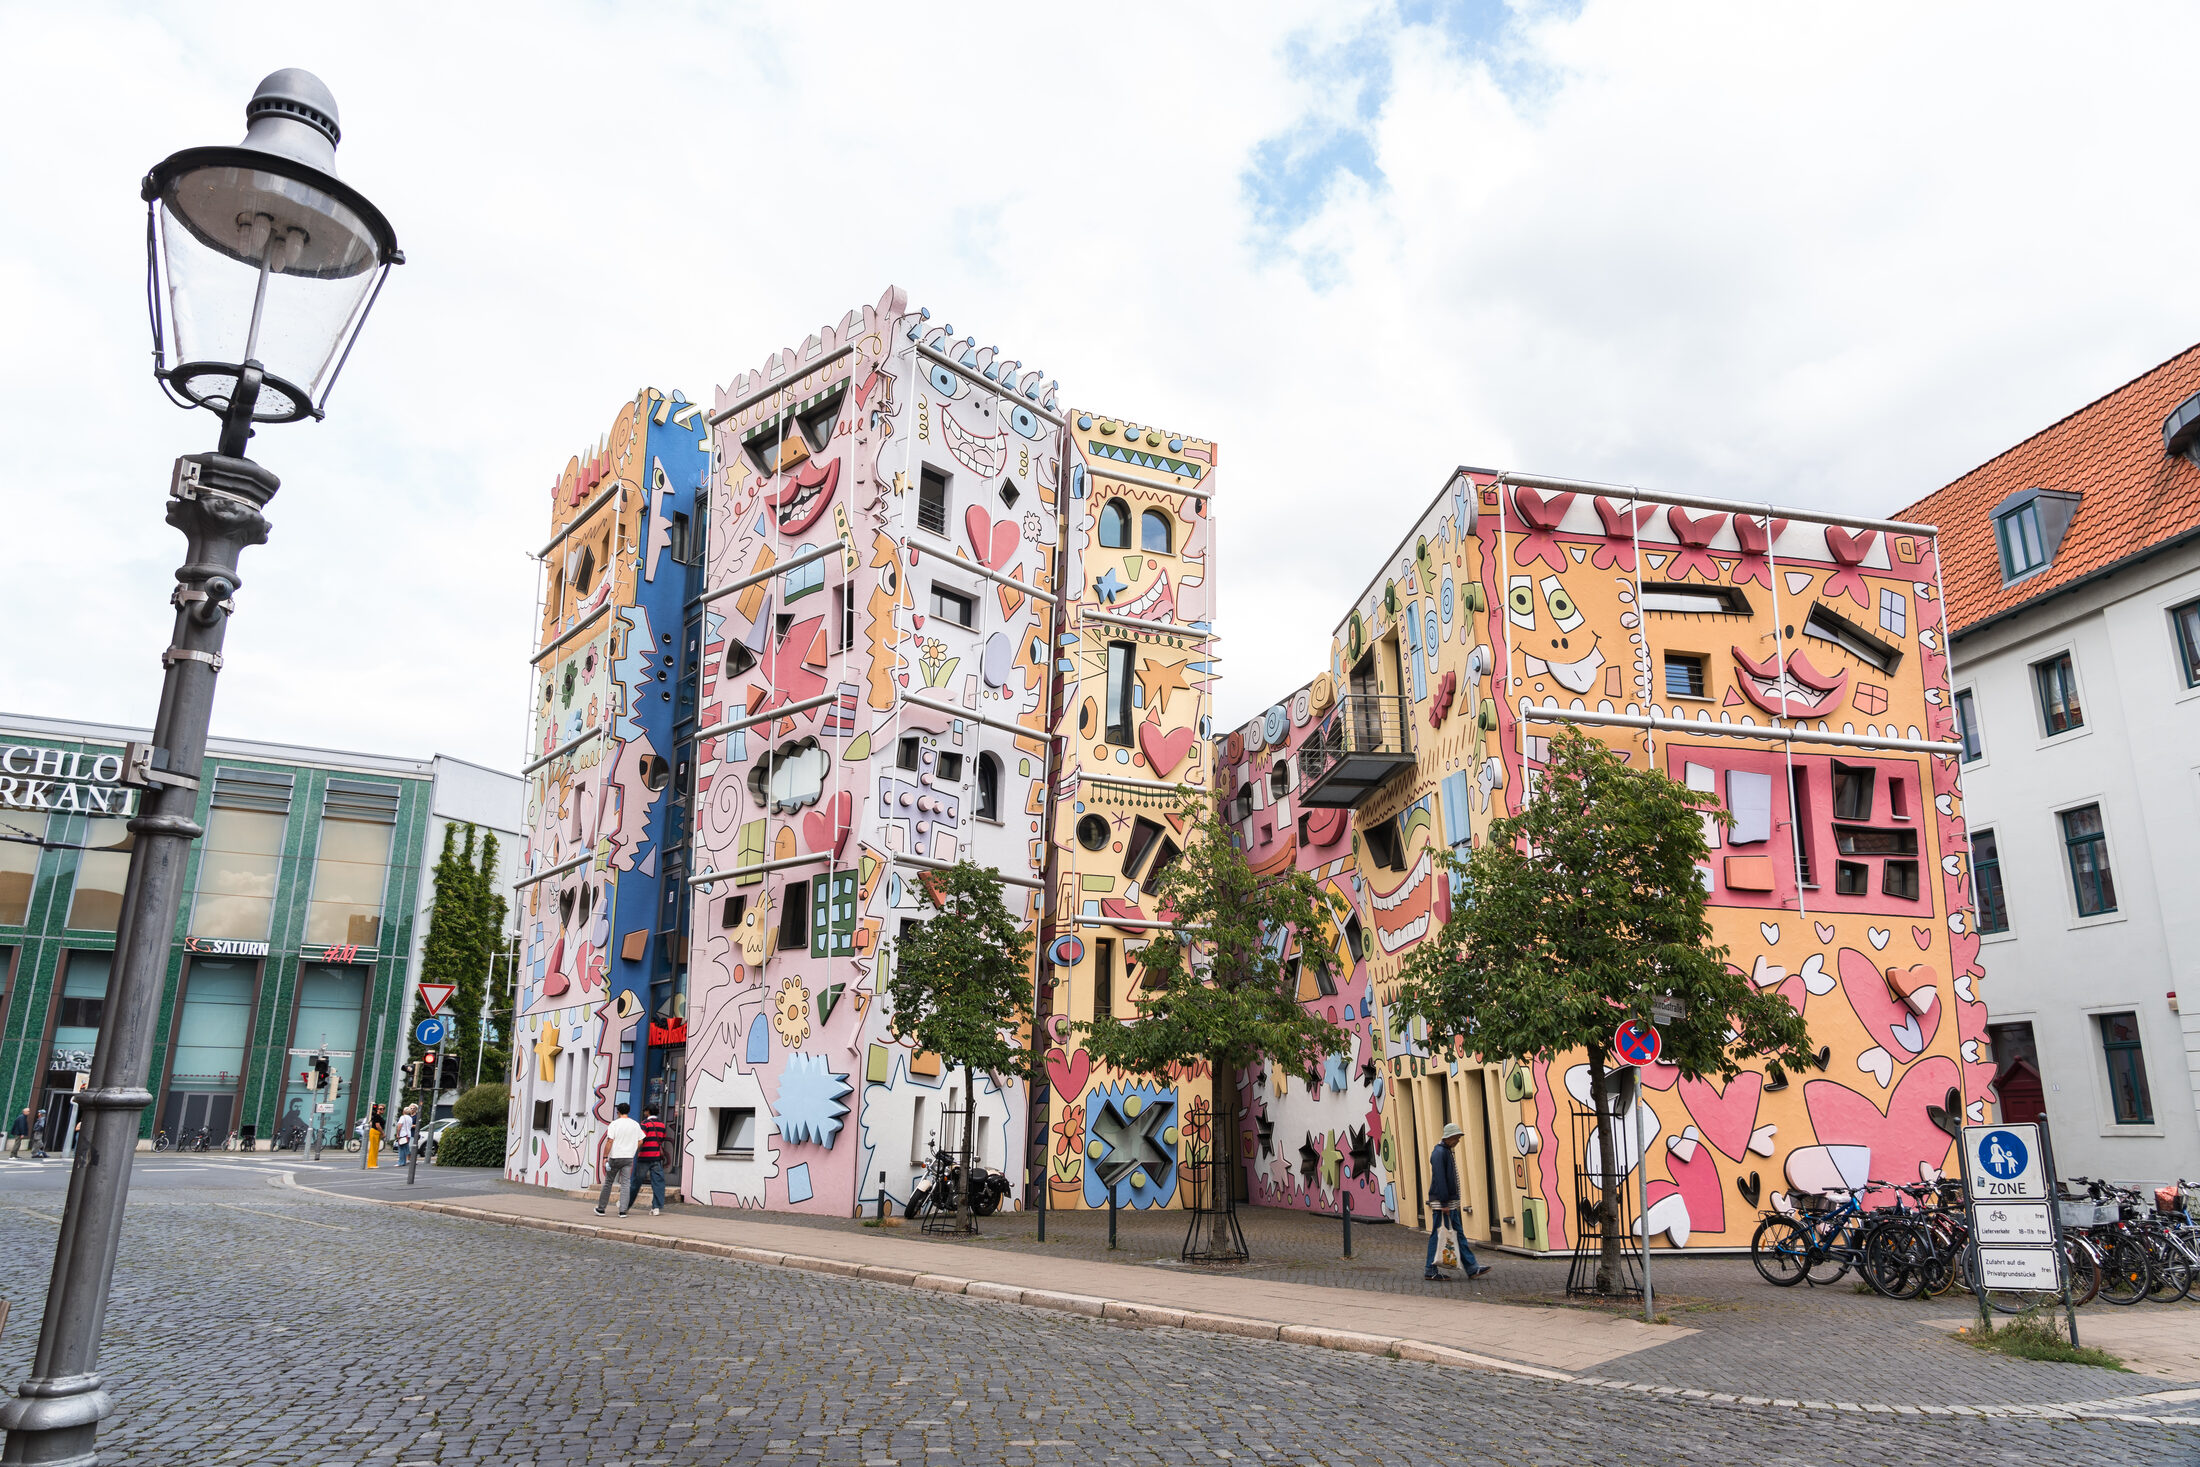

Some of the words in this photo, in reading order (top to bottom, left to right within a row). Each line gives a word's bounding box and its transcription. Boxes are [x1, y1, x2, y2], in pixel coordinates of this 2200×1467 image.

[213, 940, 270, 956] SATURN
[322, 944, 359, 964] H&M
[1989, 1183, 2027, 1195] ZONE
